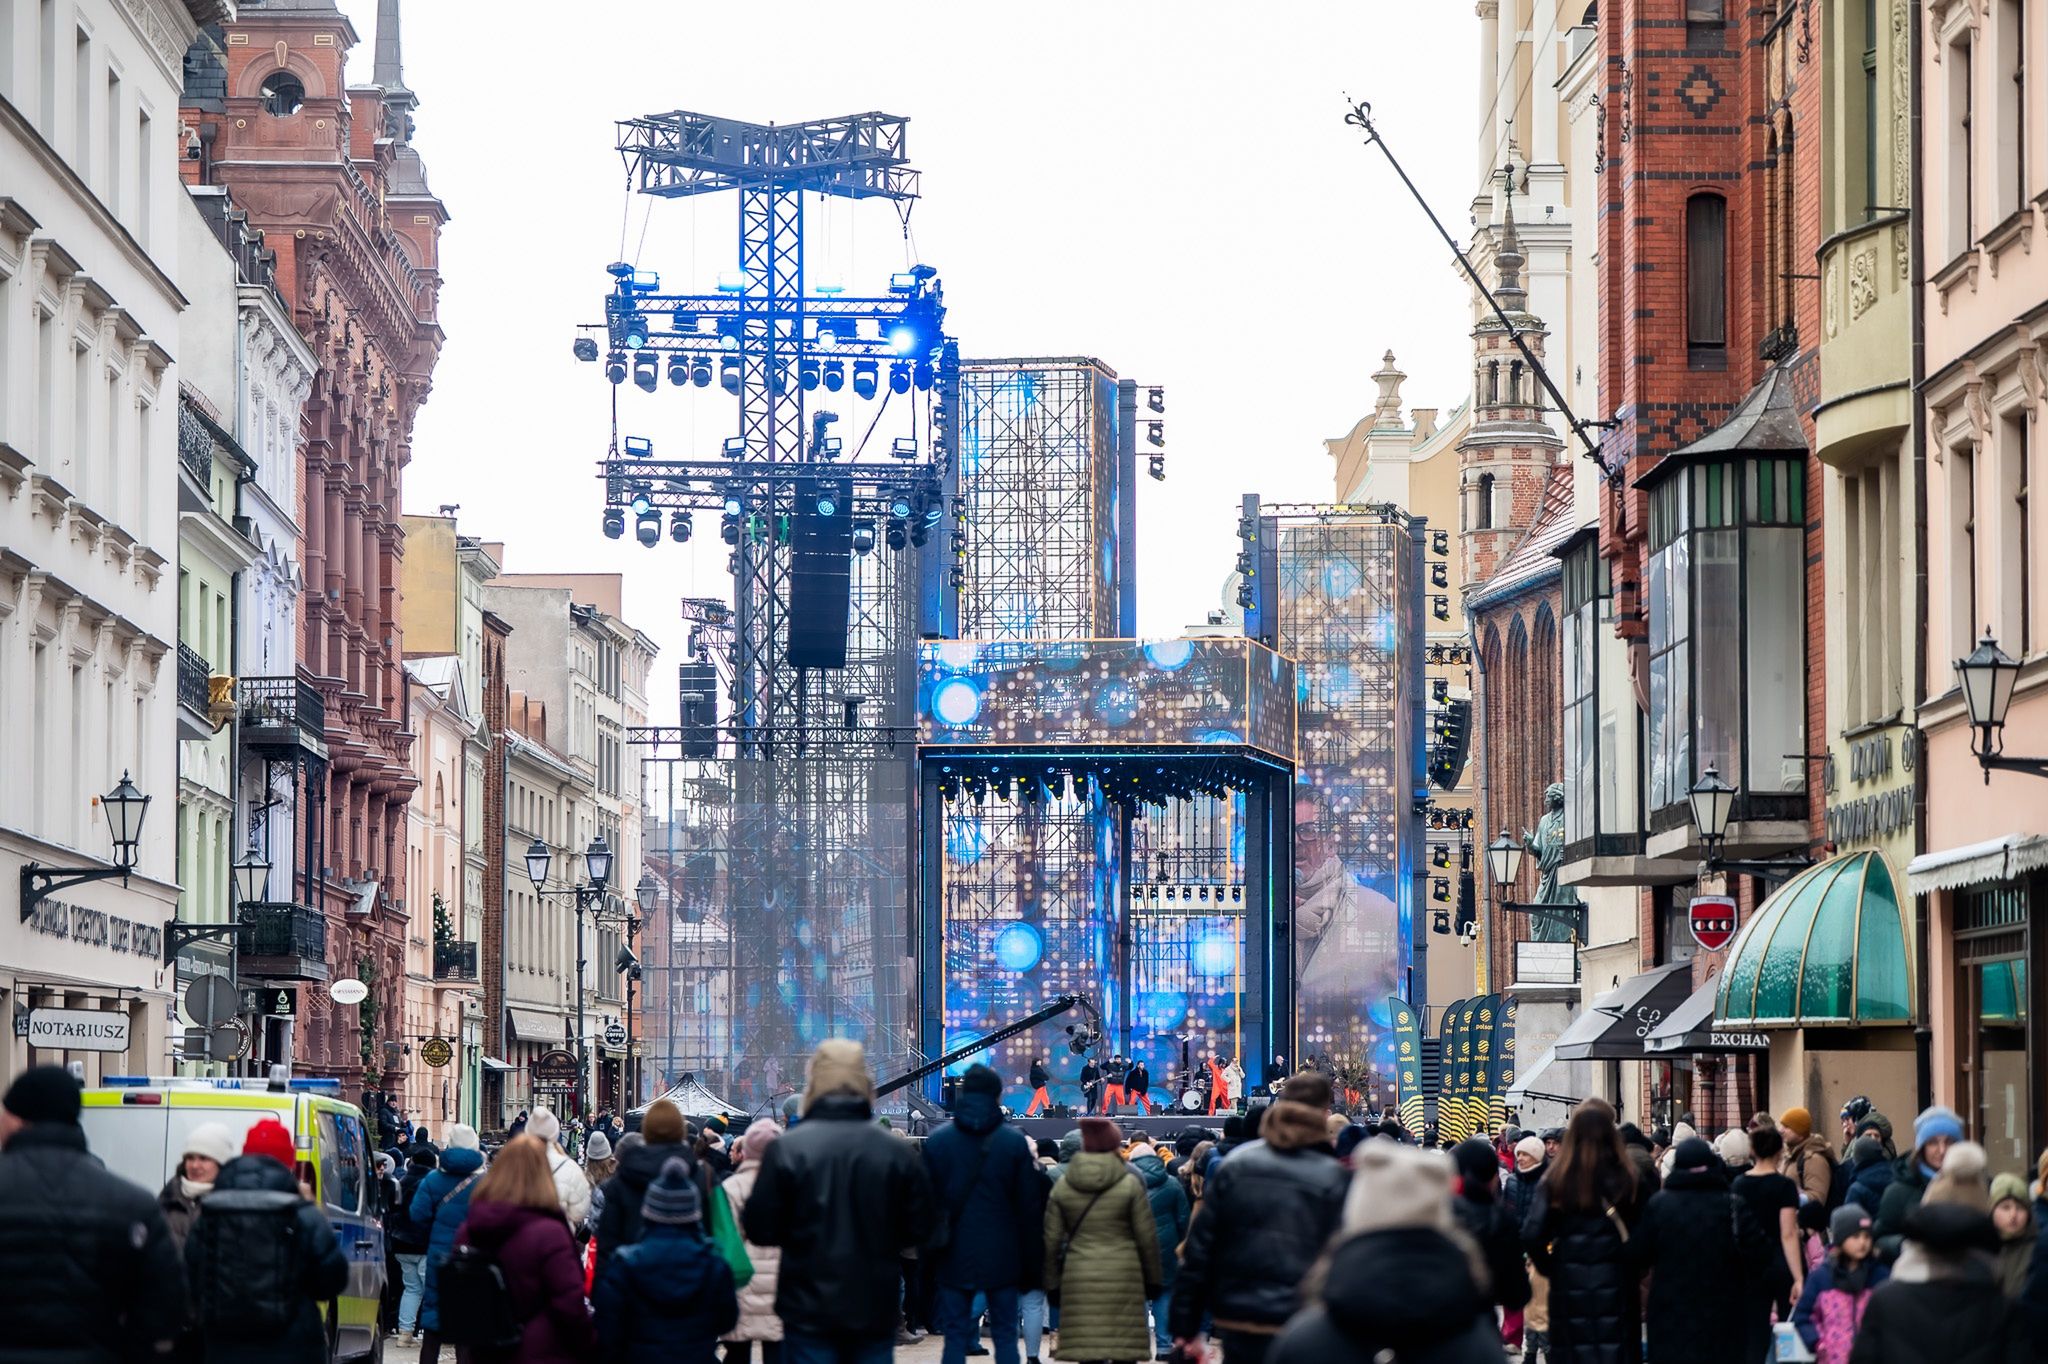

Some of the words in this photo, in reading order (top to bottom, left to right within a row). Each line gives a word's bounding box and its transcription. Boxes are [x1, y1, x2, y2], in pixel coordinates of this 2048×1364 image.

[1850, 732, 1888, 783] DOM
[32, 1021, 125, 1039] NOTARIUSZ
[1710, 1033, 1770, 1046] EXCHAN
